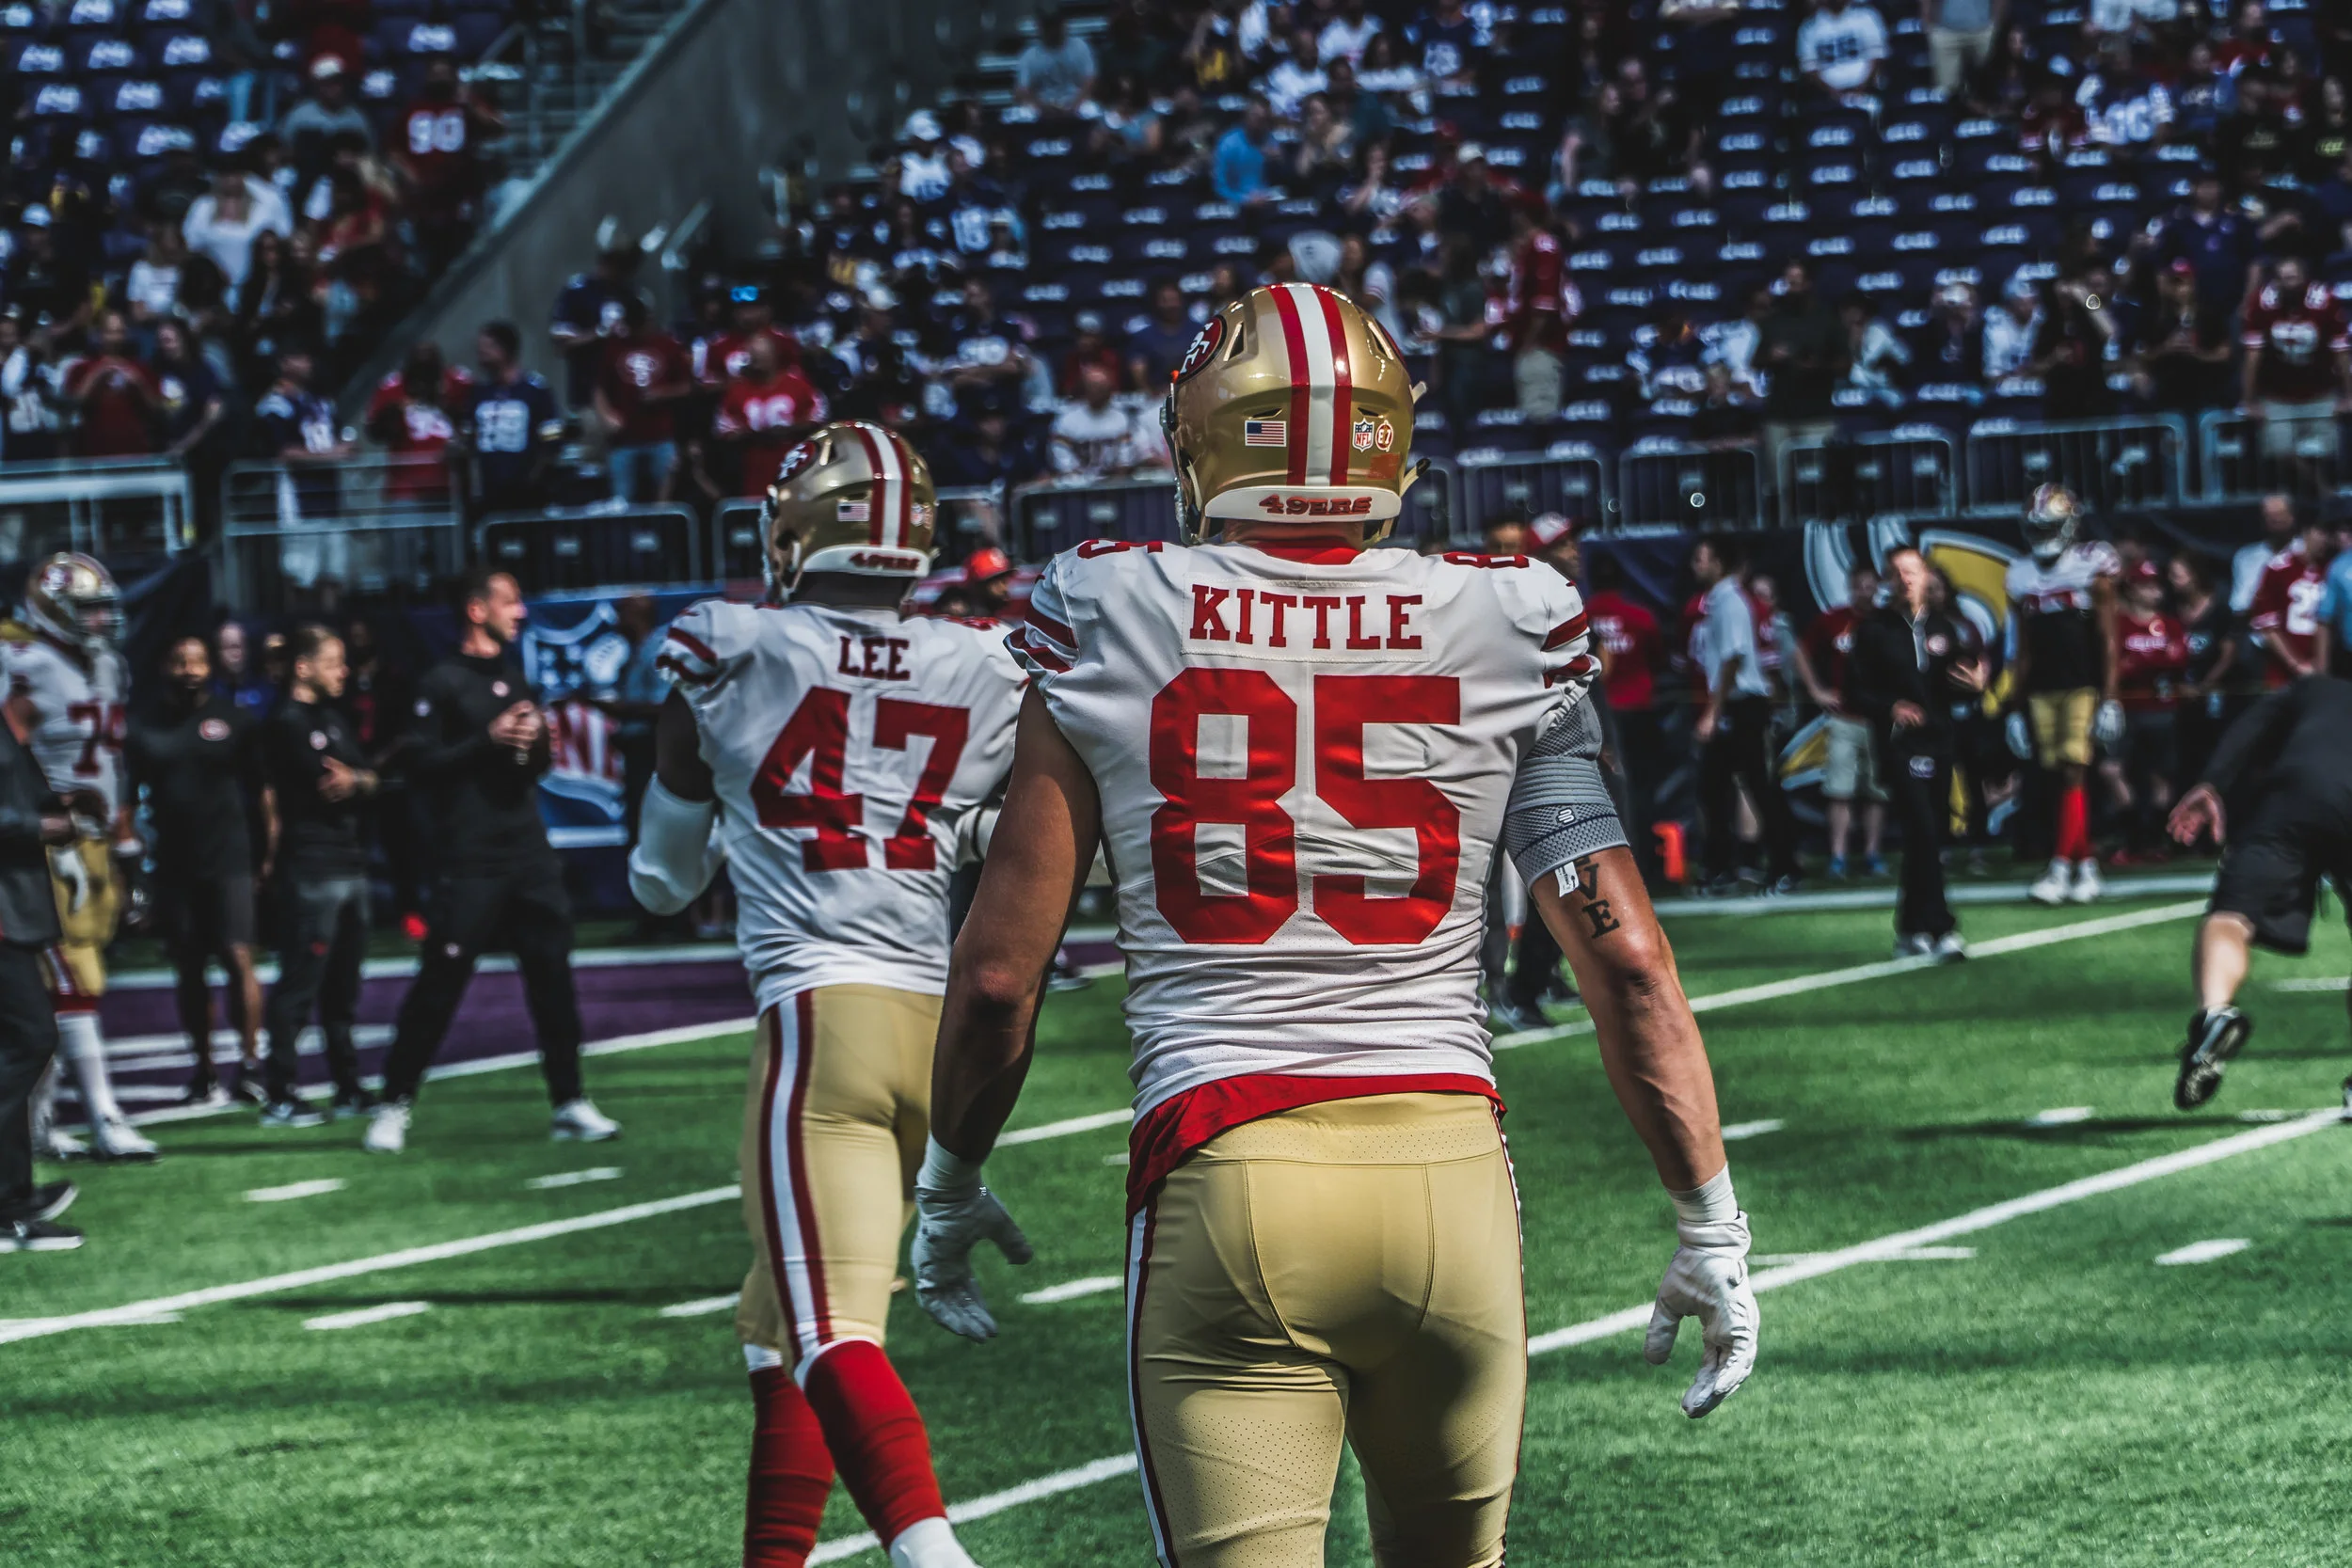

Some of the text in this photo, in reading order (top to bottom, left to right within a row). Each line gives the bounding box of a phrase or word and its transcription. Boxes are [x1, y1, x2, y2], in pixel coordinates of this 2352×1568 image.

[1356, 433, 1371, 447] NFL
[1377, 428, 1391, 444] 87
[1259, 494, 1373, 515] 49ERS
[1189, 583, 1422, 651] KITTLE
[837, 636, 911, 681] LEE
[749, 685, 971, 873] 47
[1149, 666, 1461, 945] 85
